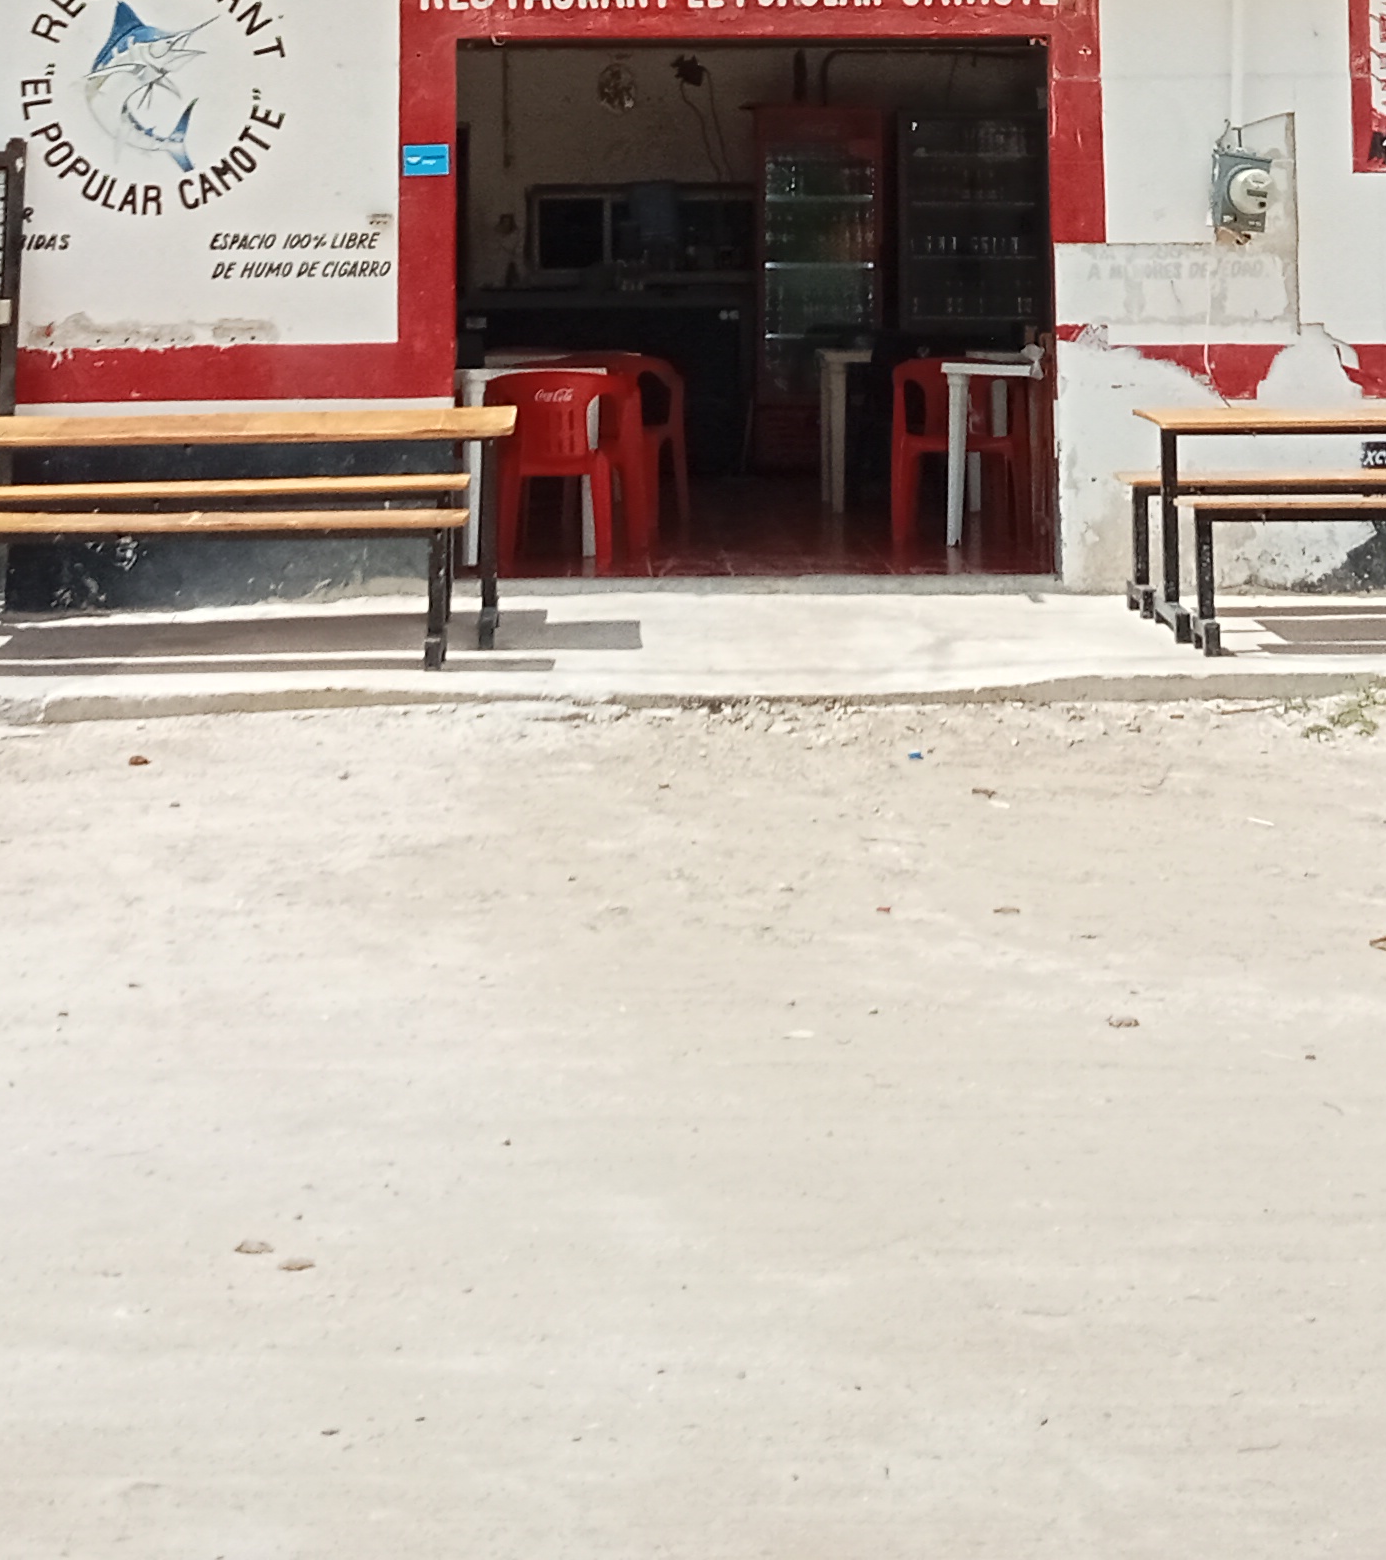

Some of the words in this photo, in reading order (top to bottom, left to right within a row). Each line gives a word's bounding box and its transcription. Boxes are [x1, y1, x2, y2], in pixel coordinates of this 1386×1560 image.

[30, 122, 163, 216] POPULAR
[209, 233, 277, 251] ESPACIO
[282, 233, 327, 250] 100%
[329, 232, 381, 249] LIBRE
[211, 261, 236, 280] DE
[239, 261, 293, 279] HUMO
[296, 261, 320, 278] DE
[321, 260, 392, 278] CIGARRO
